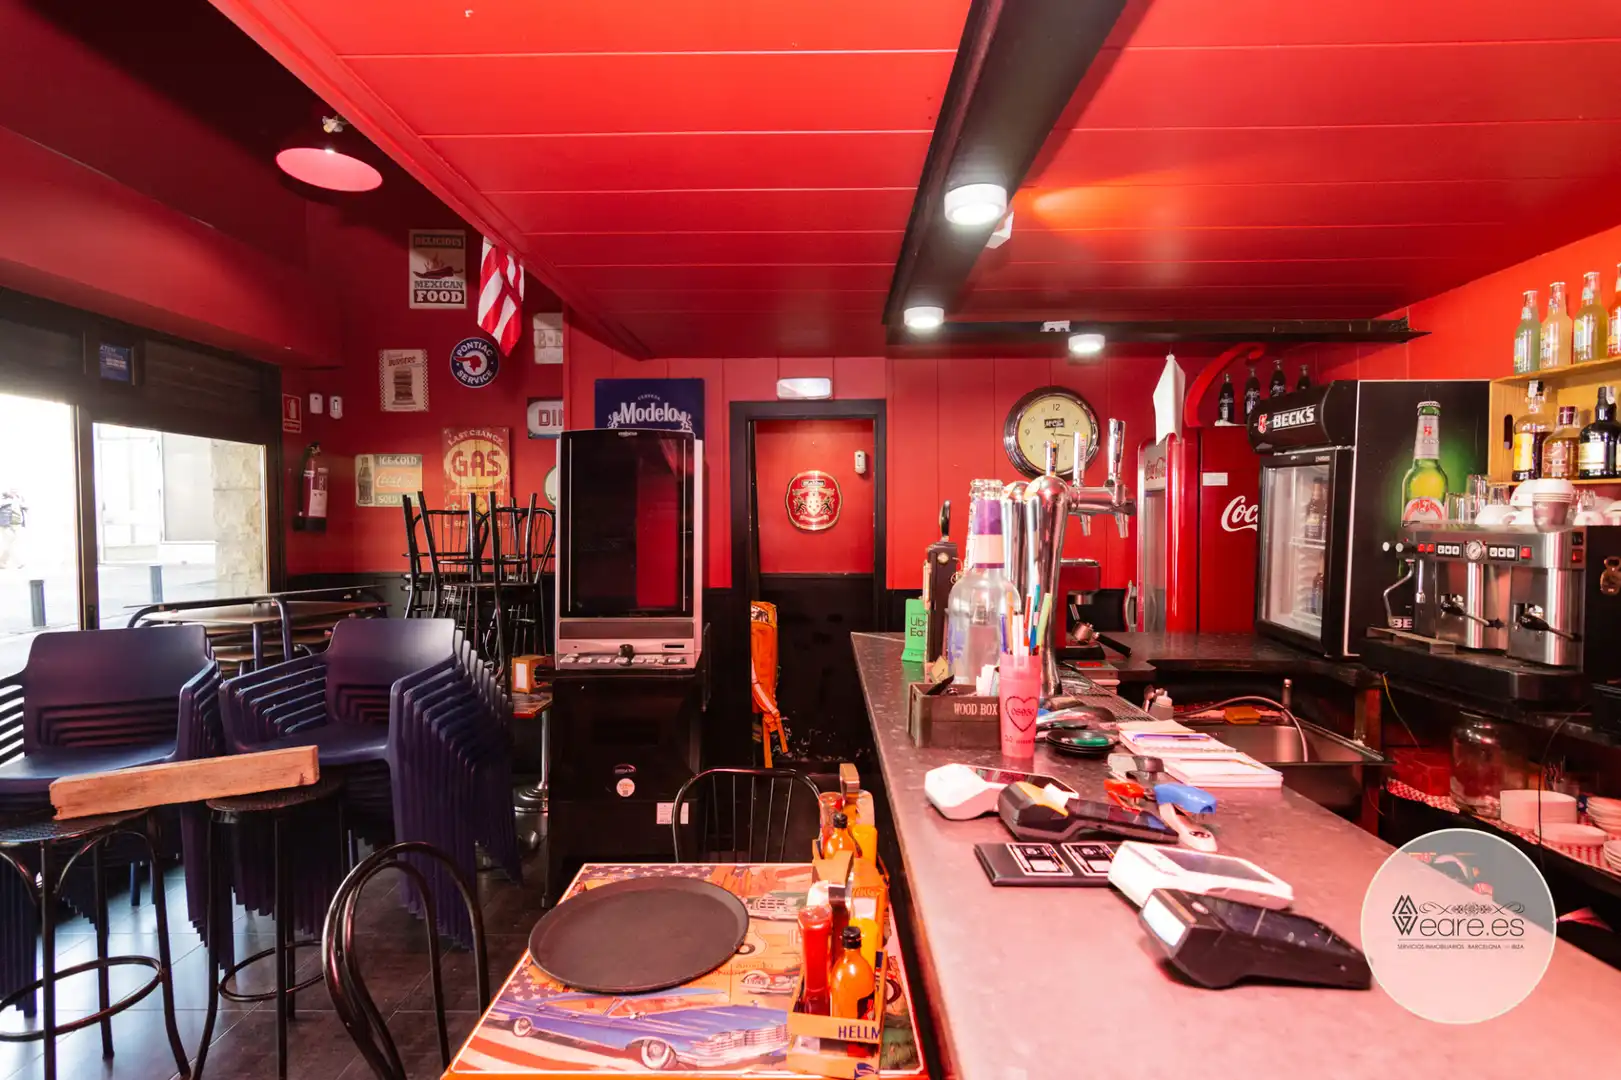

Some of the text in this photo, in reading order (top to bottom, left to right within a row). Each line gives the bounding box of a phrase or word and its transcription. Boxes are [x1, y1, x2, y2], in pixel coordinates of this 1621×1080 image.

[416, 290, 462, 302] FOOD
[456, 341, 493, 356] PONTIAC
[456, 369, 493, 385] SERVICE
[620, 402, 678, 424] Modelo
[1052, 403, 1061, 411] 12
[1273, 406, 1315, 428] BECK'S
[447, 429, 504, 446] LAST CHANCE
[452, 450, 502, 477] GAS
[953, 702, 978, 715] WOOD
[980, 703, 998, 715] BOX
